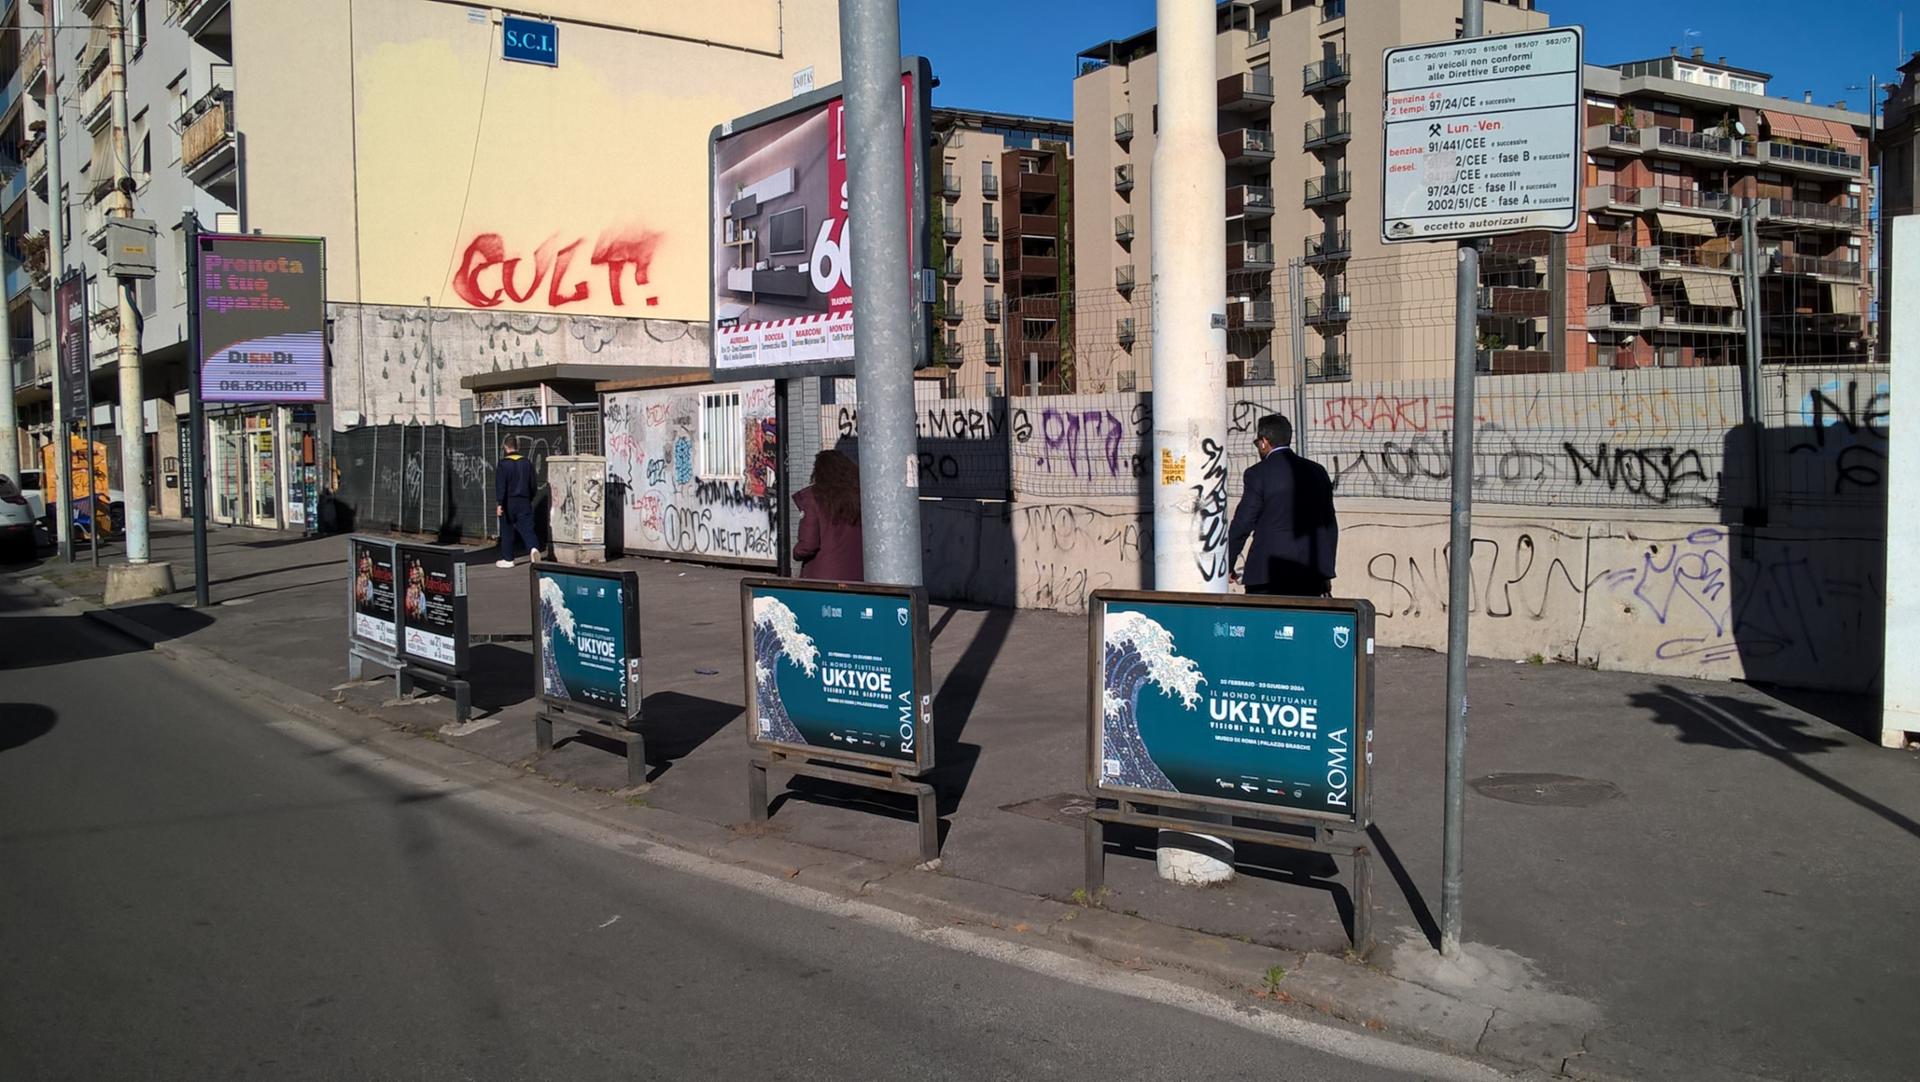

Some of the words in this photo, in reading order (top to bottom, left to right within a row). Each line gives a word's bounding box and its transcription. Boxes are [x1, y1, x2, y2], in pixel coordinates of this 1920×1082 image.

[506, 30, 553, 52] S.C.I.
[1427, 63, 1435, 71] ai
[1438, 59, 1467, 70] veicoli
[1470, 57, 1488, 67] non
[1491, 52, 1533, 65] conformi
[1428, 72, 1445, 81] alle
[1448, 66, 1488, 79] Direttive
[1492, 62, 1532, 75] Europee
[1392, 94, 1425, 105] benzina
[1429, 96, 1476, 113] 97/24/CE
[1485, 97, 1516, 105] successive
[1391, 107, 1398, 115] 2
[1428, 137, 1486, 153] 91/441/CEE
[1496, 138, 1528, 147] successive
[1498, 152, 1519, 163] fase
[1522, 150, 1530, 161] B
[1538, 152, 1570, 161] successive
[1489, 170, 1521, 179] successive
[1427, 183, 1474, 198] 97/24/CE
[1485, 182, 1506, 193] fase
[1525, 182, 1557, 191] successive
[1427, 197, 1487, 211] 2002/51/CE
[1498, 195, 1519, 206] fase
[1522, 194, 1530, 205] A
[1538, 195, 1570, 204] successive
[1424, 222, 1465, 232] eccetto
[1469, 215, 1529, 229] autorizzati
[205, 254, 304, 274] Prenota
[205, 273, 222, 290] il
[227, 274, 269, 291] tuo
[206, 292, 290, 313] spazio.
[577, 636, 615, 658] UKIYOE
[822, 667, 892, 693] UKIYOE
[1222, 691, 1256, 700] MONDO
[1261, 694, 1318, 706] FLUTTUANTE
[898, 690, 914, 754] ROMA
[1210, 698, 1318, 730] UKIYOE
[1210, 722, 1243, 731] VISIONI
[1249, 726, 1265, 734] DAL
[1271, 728, 1317, 739] GIAPPONE
[1326, 727, 1348, 807] ROMA
